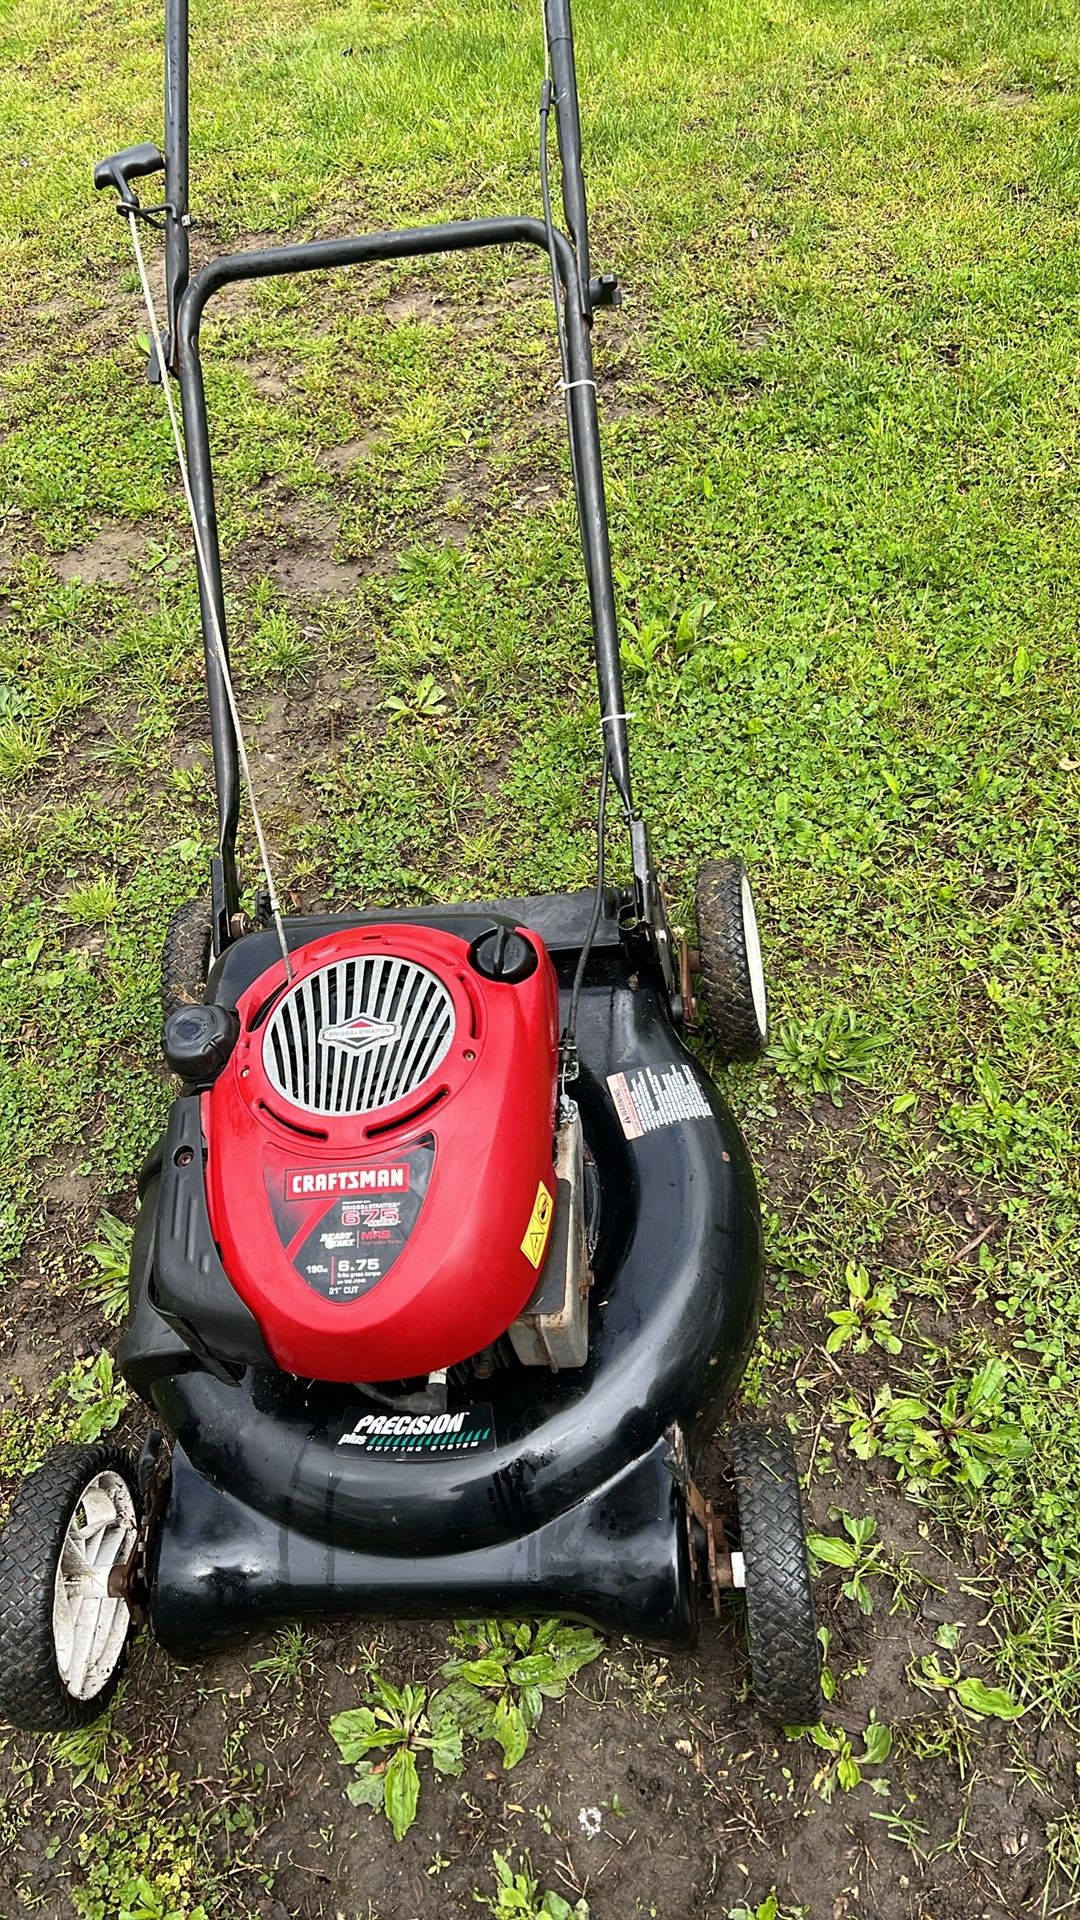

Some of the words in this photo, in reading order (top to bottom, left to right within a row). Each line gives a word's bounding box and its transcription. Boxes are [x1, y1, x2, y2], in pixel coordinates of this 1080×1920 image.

[292, 1168, 404, 1194] CRAFTSMAN
[341, 1208, 400, 1226] 675
[338, 1258, 379, 1272] 6.75
[343, 1286, 359, 1294] CUT
[353, 1412, 467, 1436] PRECISION
[338, 1432, 368, 1446] plus
[430, 1441, 479, 1452] SYSTEM
